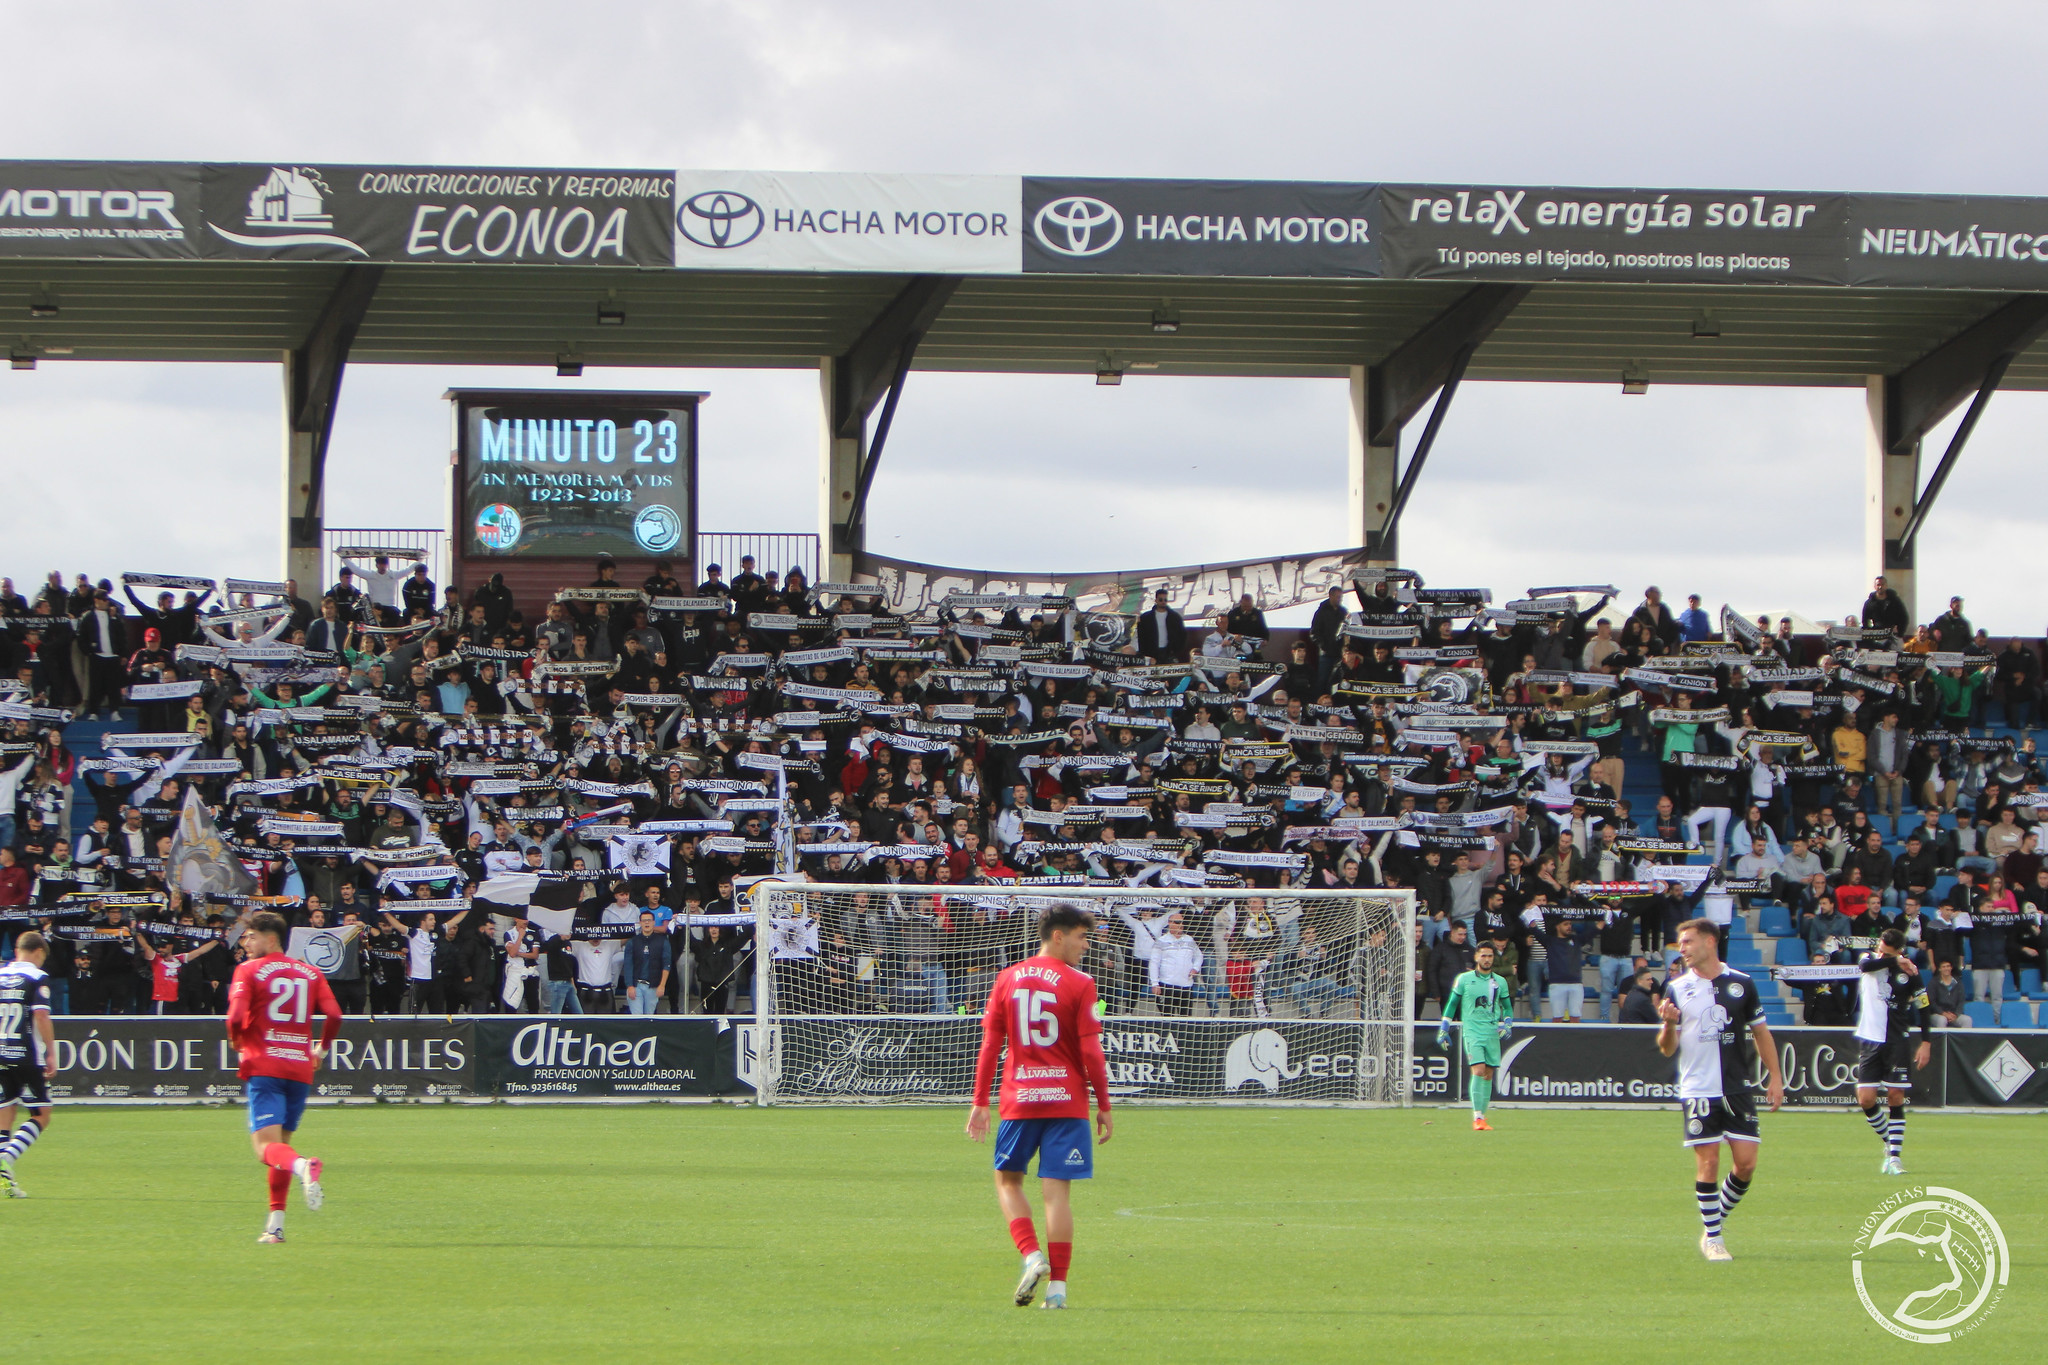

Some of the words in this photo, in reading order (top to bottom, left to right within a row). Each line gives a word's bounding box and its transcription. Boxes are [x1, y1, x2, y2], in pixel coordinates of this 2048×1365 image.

[359, 173, 542, 195] CONSTRUCCIONES
[547, 176, 561, 195] Y
[564, 177, 674, 198] REFORMAS
[1536, 194, 1692, 234] energía
[1704, 196, 1816, 228] solar
[773, 209, 884, 234] HACHA
[895, 212, 1008, 237] MOTOR
[1136, 214, 1244, 241] HACHA
[1255, 216, 1369, 242] MOTOR
[407, 204, 627, 258] ECONOA
[1438, 247, 1460, 263] Tú
[1465, 250, 1521, 268] pones
[1526, 250, 1541, 264] el
[1547, 250, 1610, 270] tejado,
[1614, 253, 1693, 268] nosotros
[1698, 252, 1725, 268] las
[1729, 252, 1791, 274] placas
[481, 419, 616, 463] MINUTO
[634, 419, 678, 464] 23
[635, 475, 673, 487] VDS
[469, 645, 528, 658] UNIONISTAS
[1354, 685, 1382, 693] NUNCA
[1383, 686, 1393, 694] SE
[1394, 686, 1418, 694] RINDE
[1403, 704, 1466, 713] UNIONISTAS
[905, 718, 962, 736] UNIONISTAS
[1255, 748, 1265, 756] SE
[93, 758, 157, 769] UNIONISTAS
[1064, 756, 1127, 765] UNIONISTAS
[345, 770, 354, 779] SE
[355, 771, 381, 780] RINDE
[566, 779, 633, 794] UNIONISTAS
[1161, 781, 1186, 791] NUNCA
[1187, 783, 1198, 792] SE
[1199, 784, 1222, 793] RINDE
[1428, 835, 1469, 845] MEMORIAM
[1648, 841, 1658, 849] SE
[1659, 842, 1684, 850] RINDE
[883, 845, 944, 856] UNIONISTAS
[1101, 845, 1163, 859] UNIONISTAS
[1601, 881, 1640, 891] 1923
[112, 896, 121, 904] SE
[122, 896, 149, 904] RINDE
[1, 909, 29, 919] Against
[31, 908, 57, 917] Modern
[58, 905, 87, 915] Football
[1552, 906, 1591, 915] MEMORIAM
[575, 927, 617, 935] MEMORIAM
[1015, 966, 1042, 982] ALEX
[1043, 969, 1061, 986] GIL
[269, 977, 308, 1023] 21
[1013, 988, 1059, 1047] 15
[828, 1026, 911, 1060] Hotel
[155, 1039, 203, 1071] DE
[535, 1069, 600, 1079] PREVENCION
[602, 1069, 610, 1079] Y
[648, 1069, 696, 1079] LABORAL
[506, 1082, 529, 1092] Tfno.
[531, 1082, 578, 1092] 923616845
[614, 1083, 681, 1092] www.althea.es
[1513, 1075, 1624, 1097] Helmantic
[1688, 1098, 1710, 1118] 20
